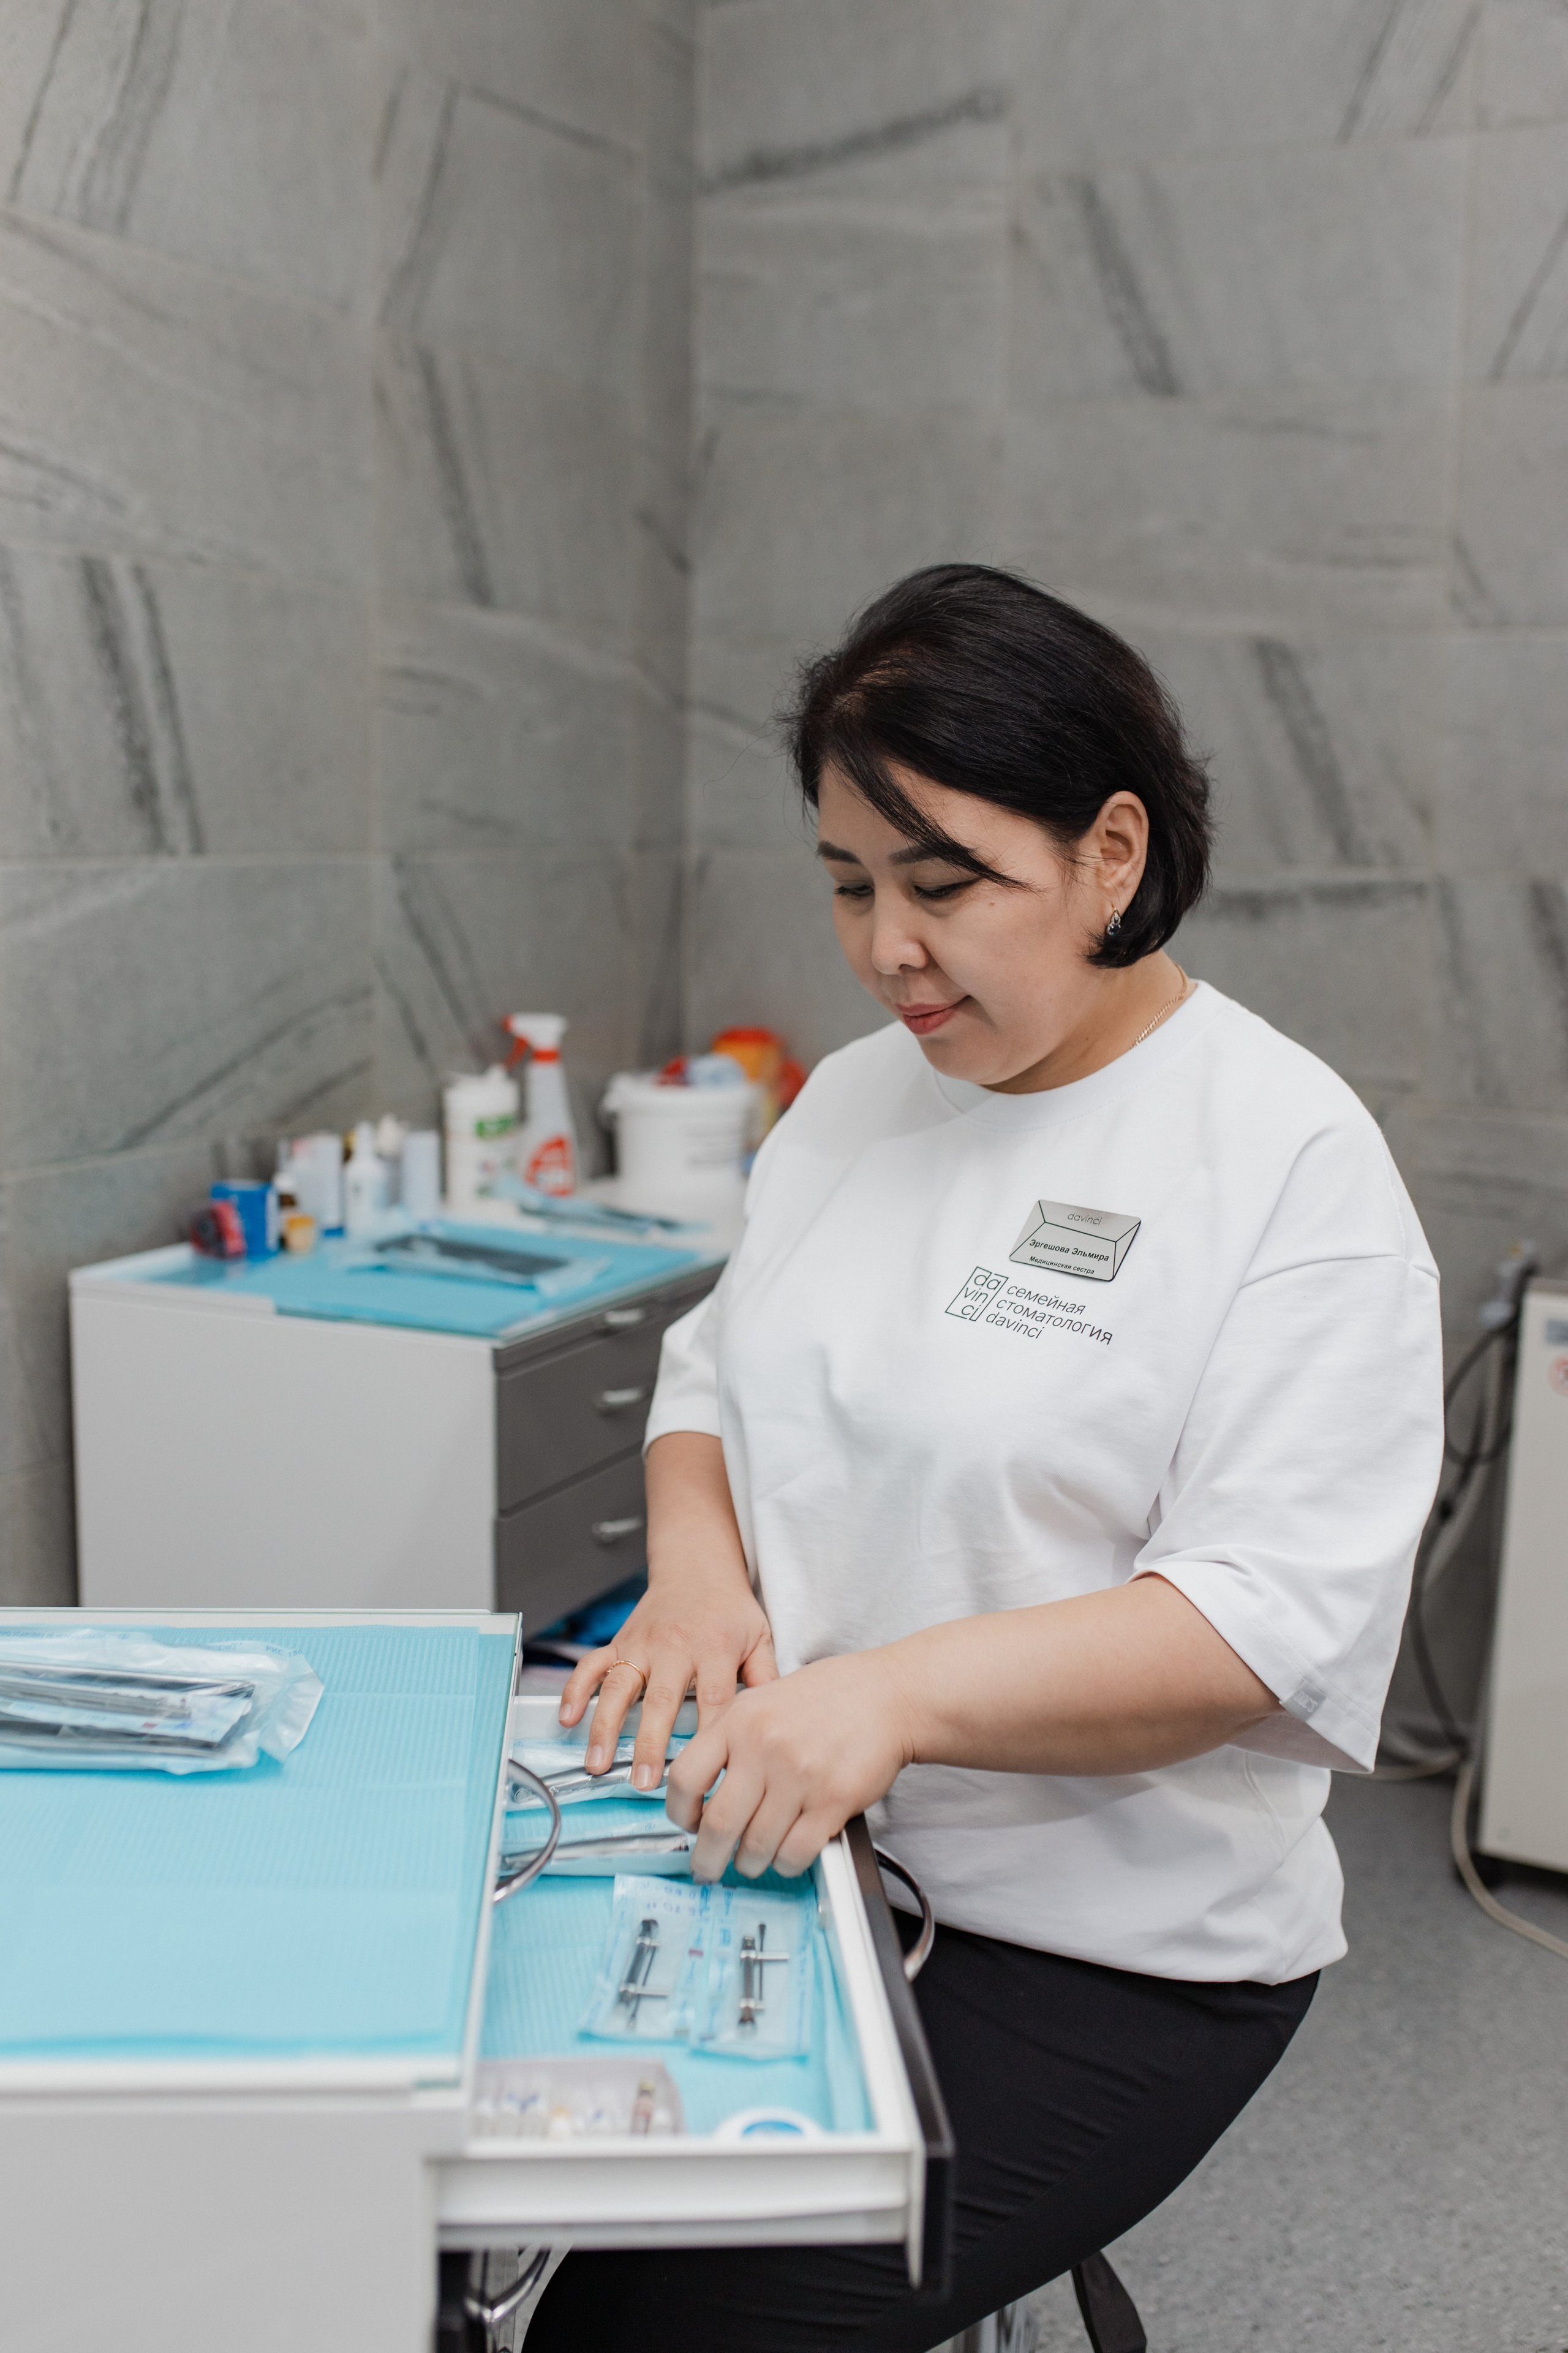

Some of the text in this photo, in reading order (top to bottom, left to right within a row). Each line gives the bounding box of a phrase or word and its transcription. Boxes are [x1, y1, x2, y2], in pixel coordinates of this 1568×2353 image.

[1067, 1212, 1103, 1226] davinci
[1029, 1239, 1110, 1262] Эргешова Эльмира
[1029, 1256, 1095, 1275] Медицинская сестра
[1007, 1285, 1086, 1315] семейная
[986, 1312, 1045, 1339] davinci
[997, 1299, 1114, 1345] стоматология
